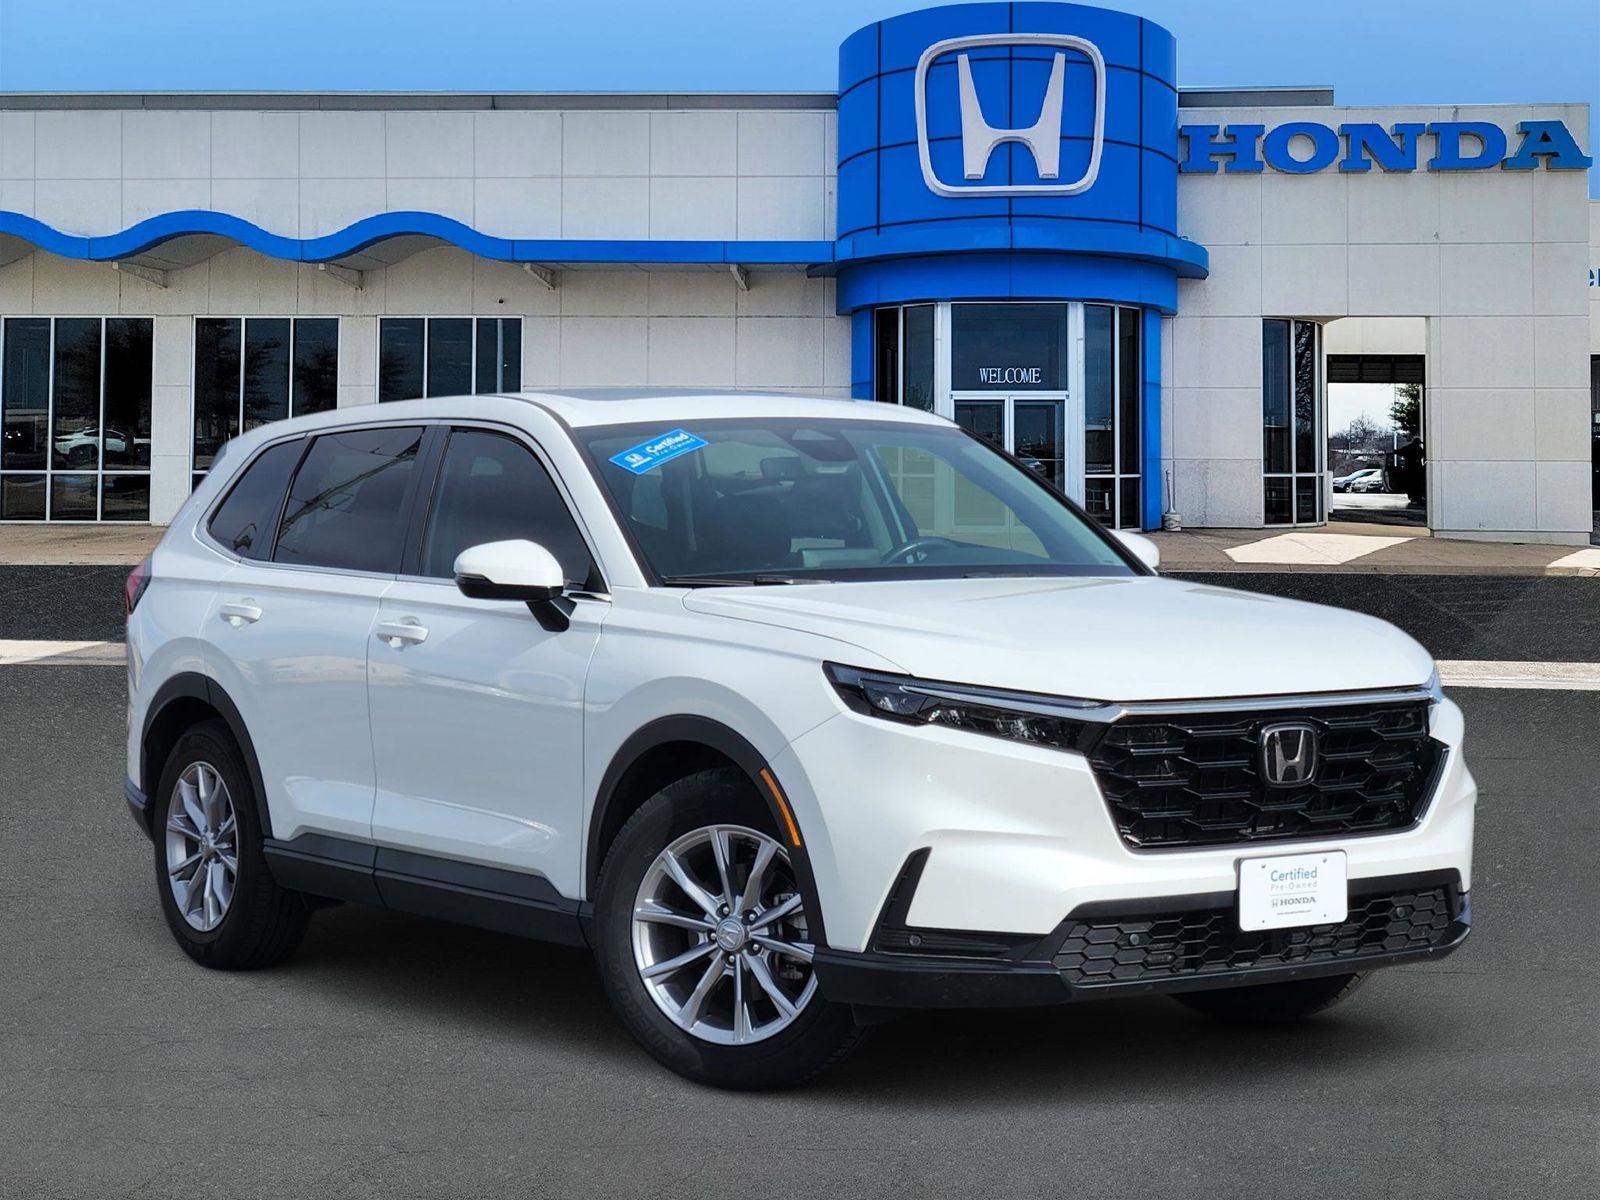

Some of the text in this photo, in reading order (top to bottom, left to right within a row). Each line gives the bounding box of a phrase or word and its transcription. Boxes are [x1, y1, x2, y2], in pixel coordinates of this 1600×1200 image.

[1178, 120, 1592, 174] HONDA
[979, 367, 1042, 384] WELCOME
[645, 432, 690, 454] Certified
[1271, 866, 1318, 882] Certified
[1270, 880, 1318, 892] Pre-Owned
[1279, 896, 1317, 906] HONDA
